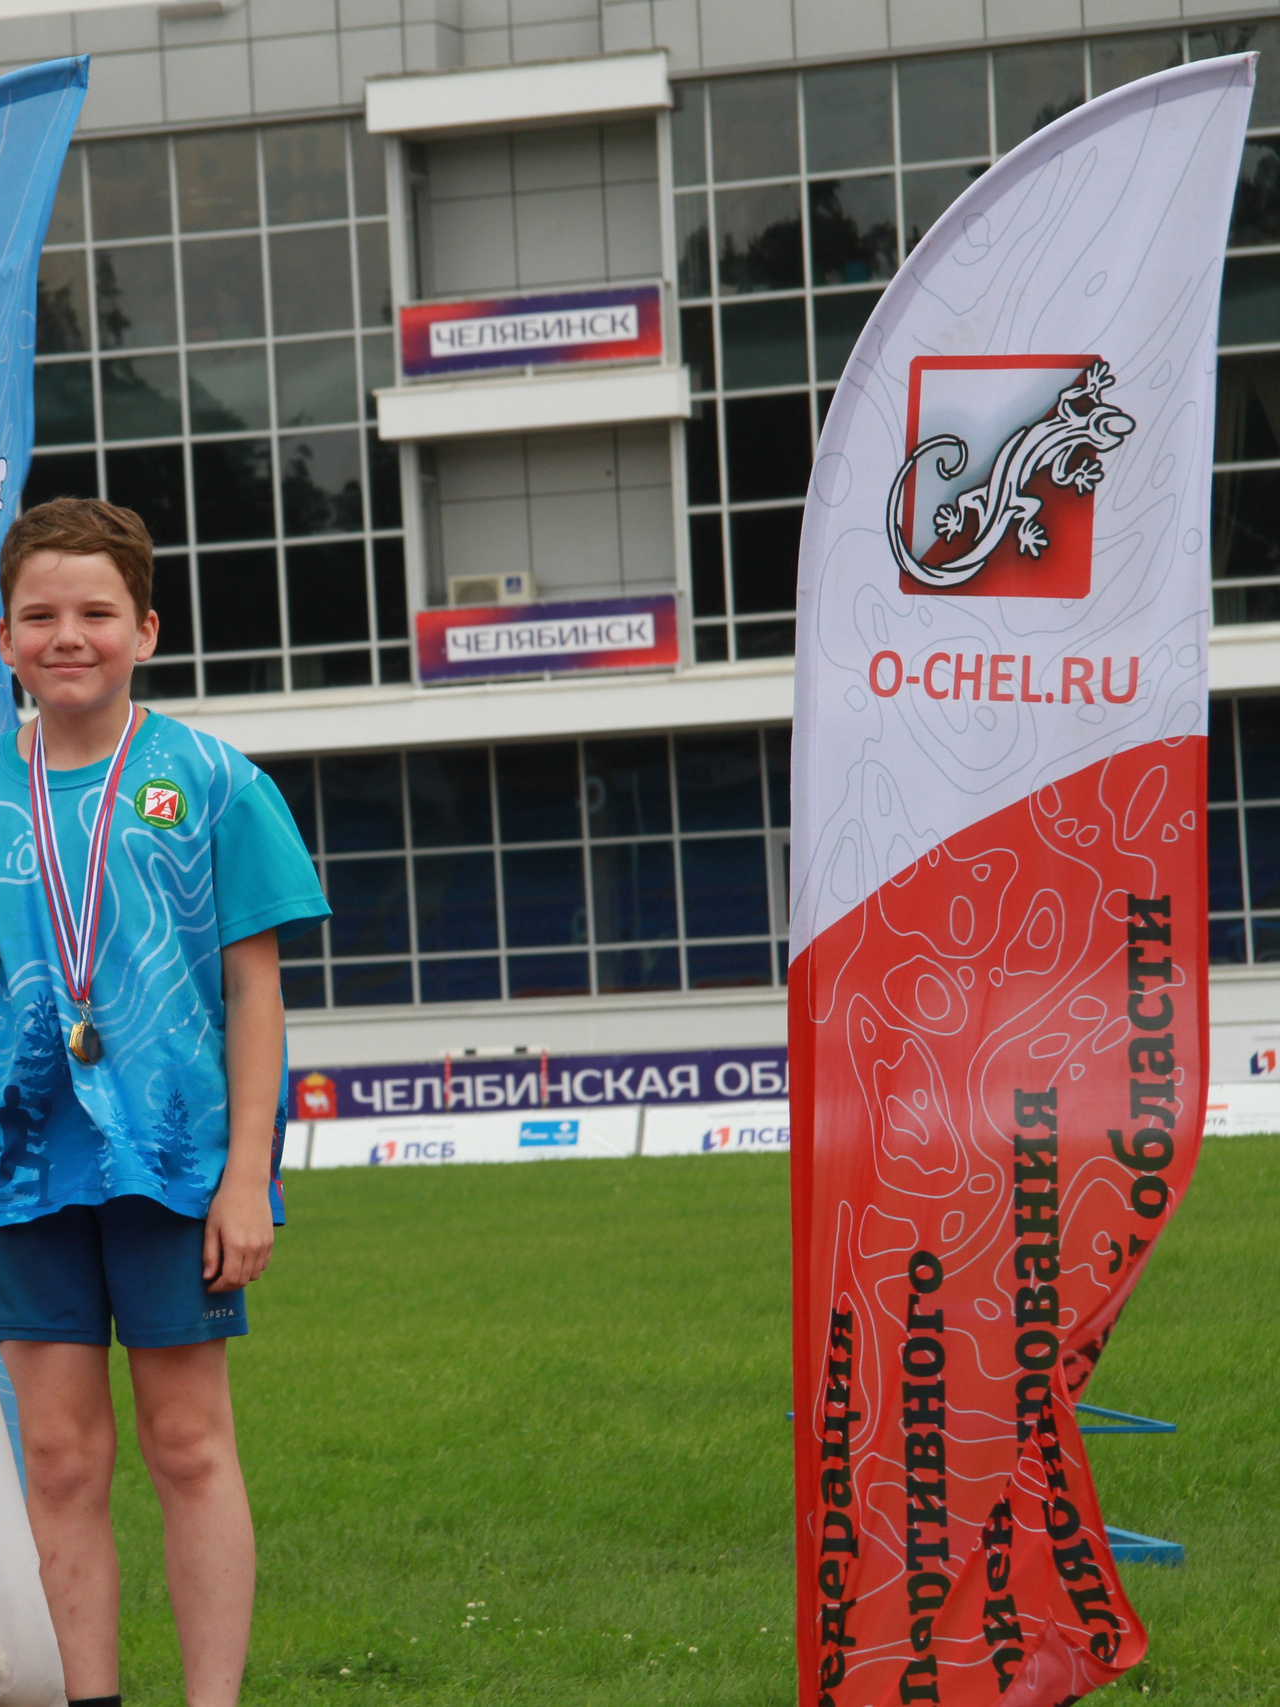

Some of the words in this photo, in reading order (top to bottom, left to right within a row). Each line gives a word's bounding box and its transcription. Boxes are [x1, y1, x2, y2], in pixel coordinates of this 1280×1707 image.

[434, 313, 630, 348] ЧЕЛЯБИНСК
[451, 620, 647, 653] ЧЕЛЯБИНСК
[868, 650, 1139, 704] O-CHEL.RU
[1107, 894, 1175, 1220] области
[351, 1064, 699, 1113] ЧЕЛЯБИНСКАЯ
[714, 1061, 789, 1097] ОБ
[404, 1141, 455, 1159] ПСБ
